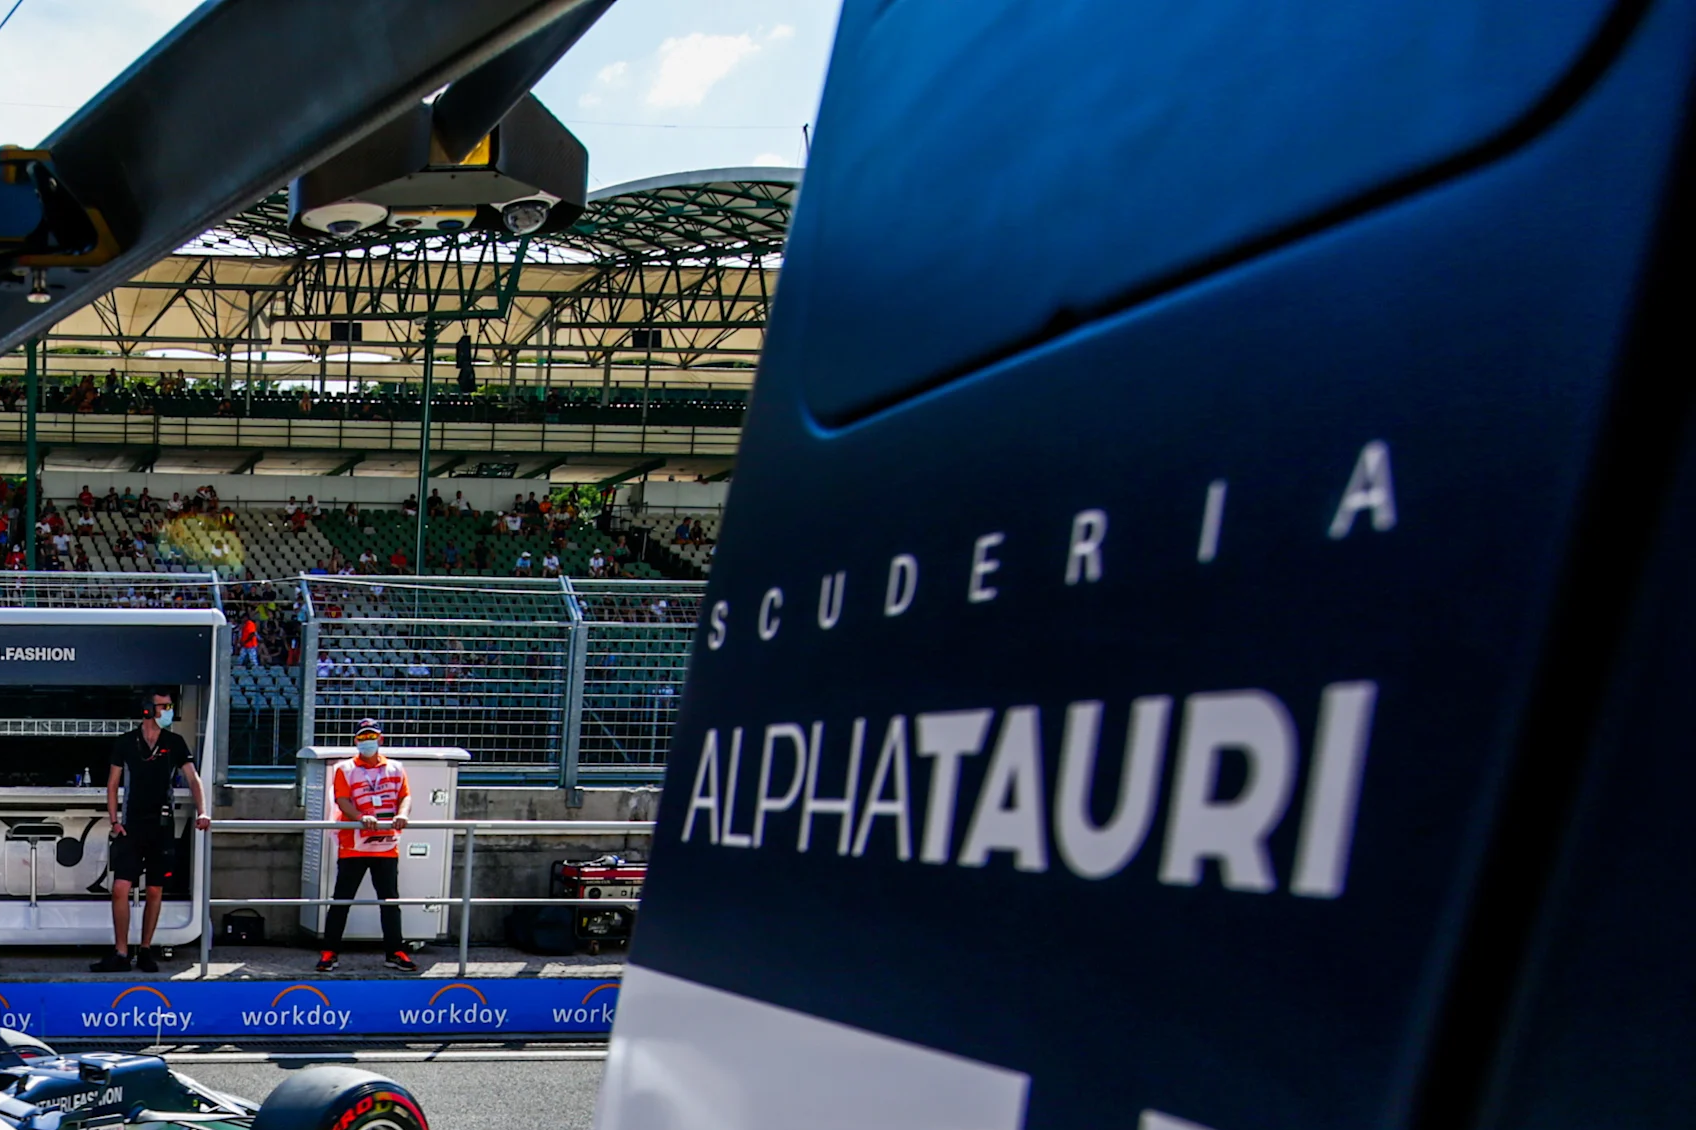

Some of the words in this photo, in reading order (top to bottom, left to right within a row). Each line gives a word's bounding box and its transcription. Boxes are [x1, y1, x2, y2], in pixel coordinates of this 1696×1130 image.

[708, 440, 1398, 651] SCUDERIA
[681, 680, 1378, 900] ALPHATAURI
[81, 1005, 192, 1034] workday
[242, 1004, 351, 1031] workday
[399, 1002, 507, 1028] workday
